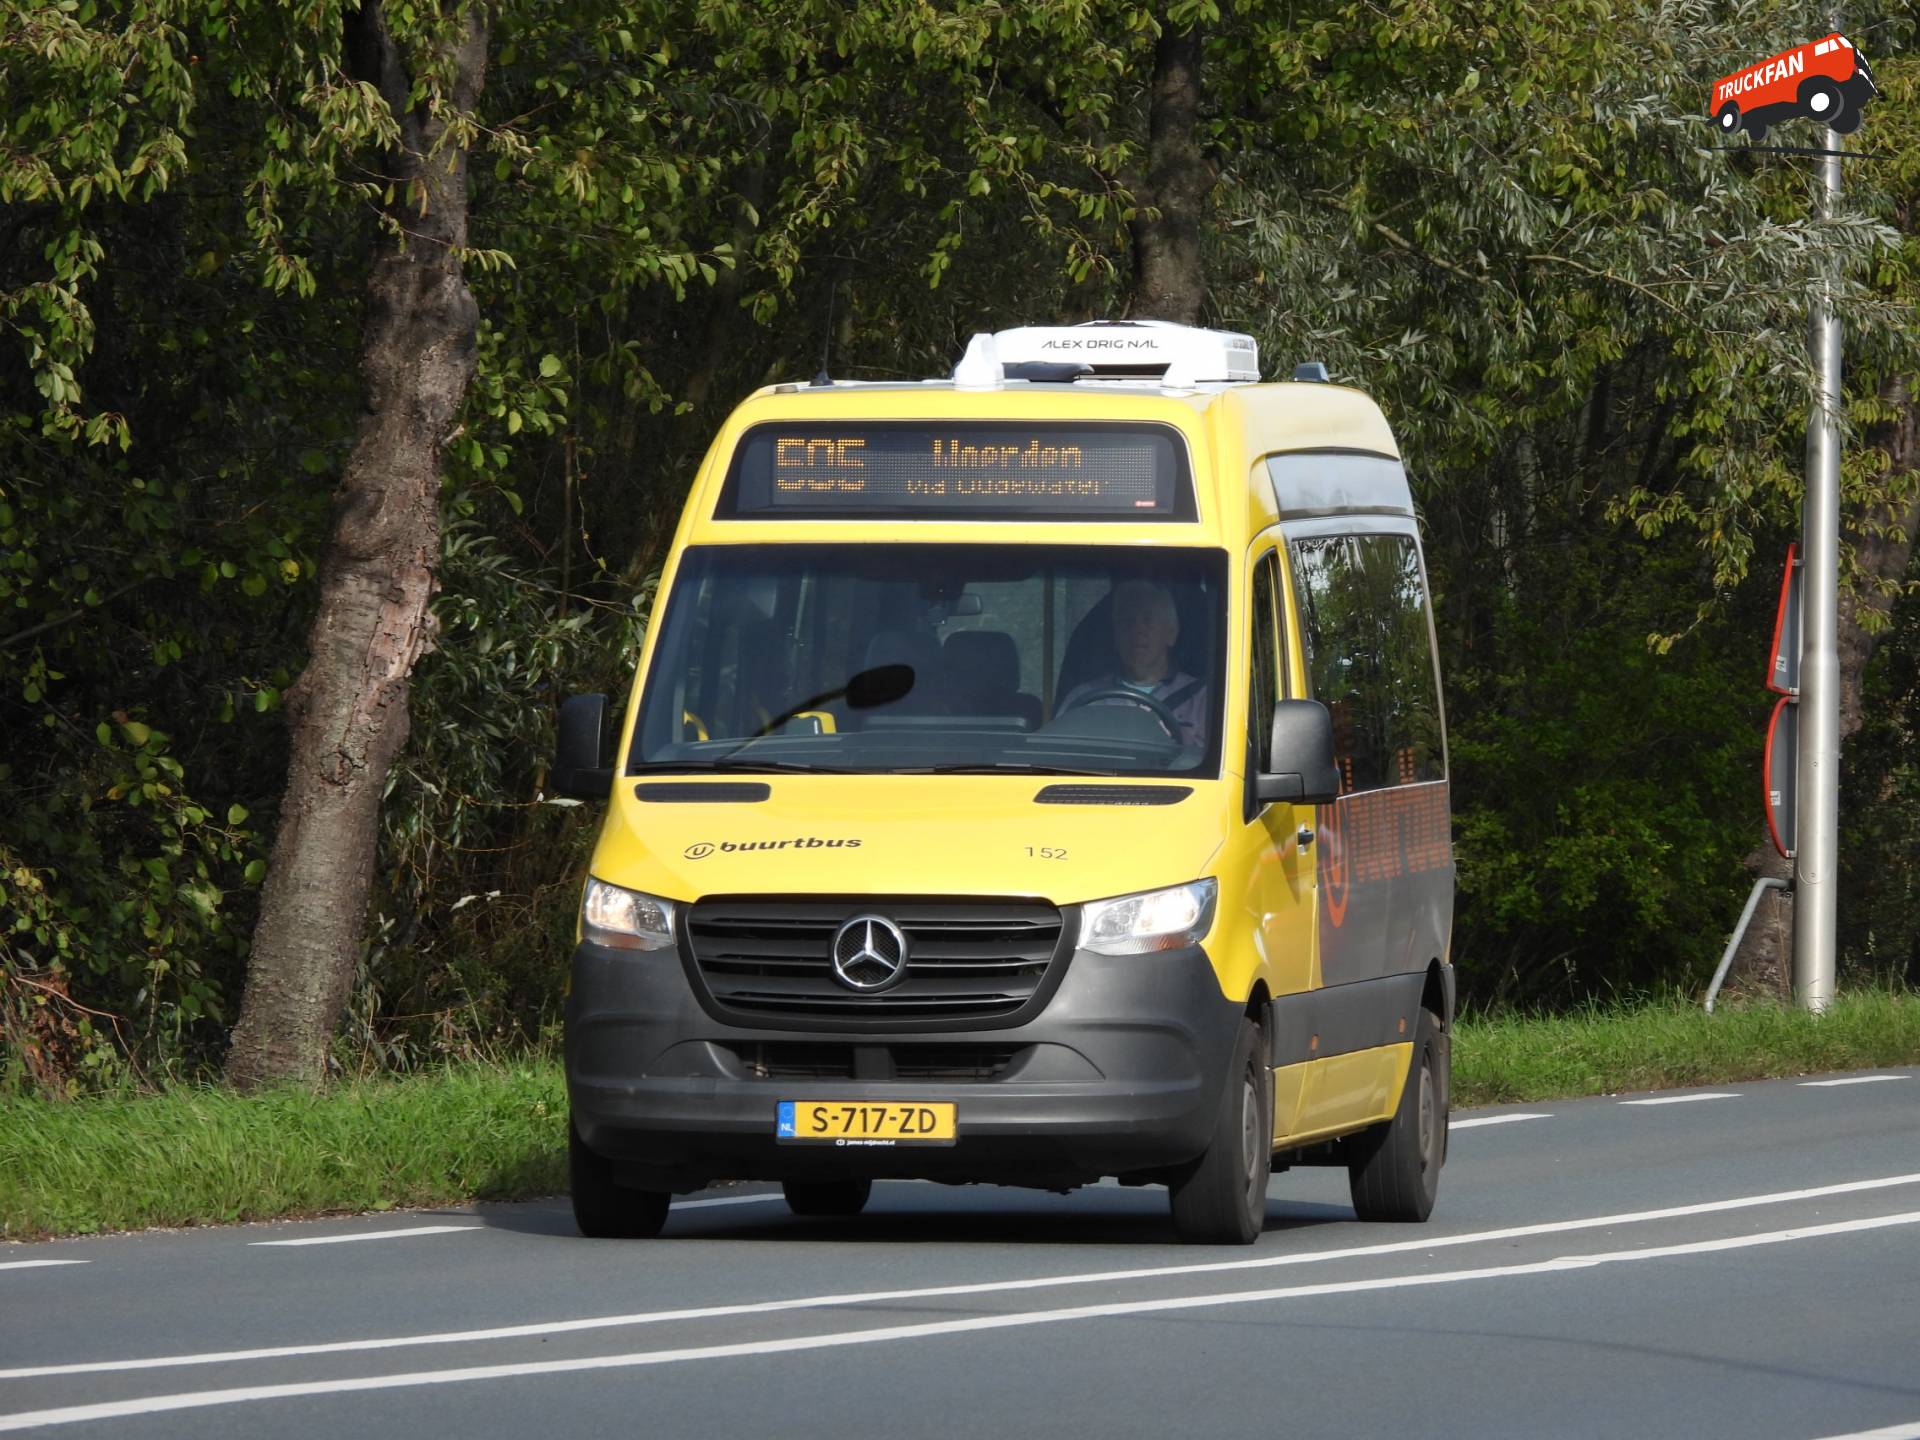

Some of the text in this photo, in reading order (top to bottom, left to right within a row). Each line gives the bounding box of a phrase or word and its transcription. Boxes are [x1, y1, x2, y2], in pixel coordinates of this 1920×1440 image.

[1041, 339, 1083, 349] ALEX
[719, 836, 863, 853] buurtbus
[1024, 846, 1069, 861] 152
[780, 1122, 794, 1132] NL
[811, 1106, 937, 1134] S-717-ZD
